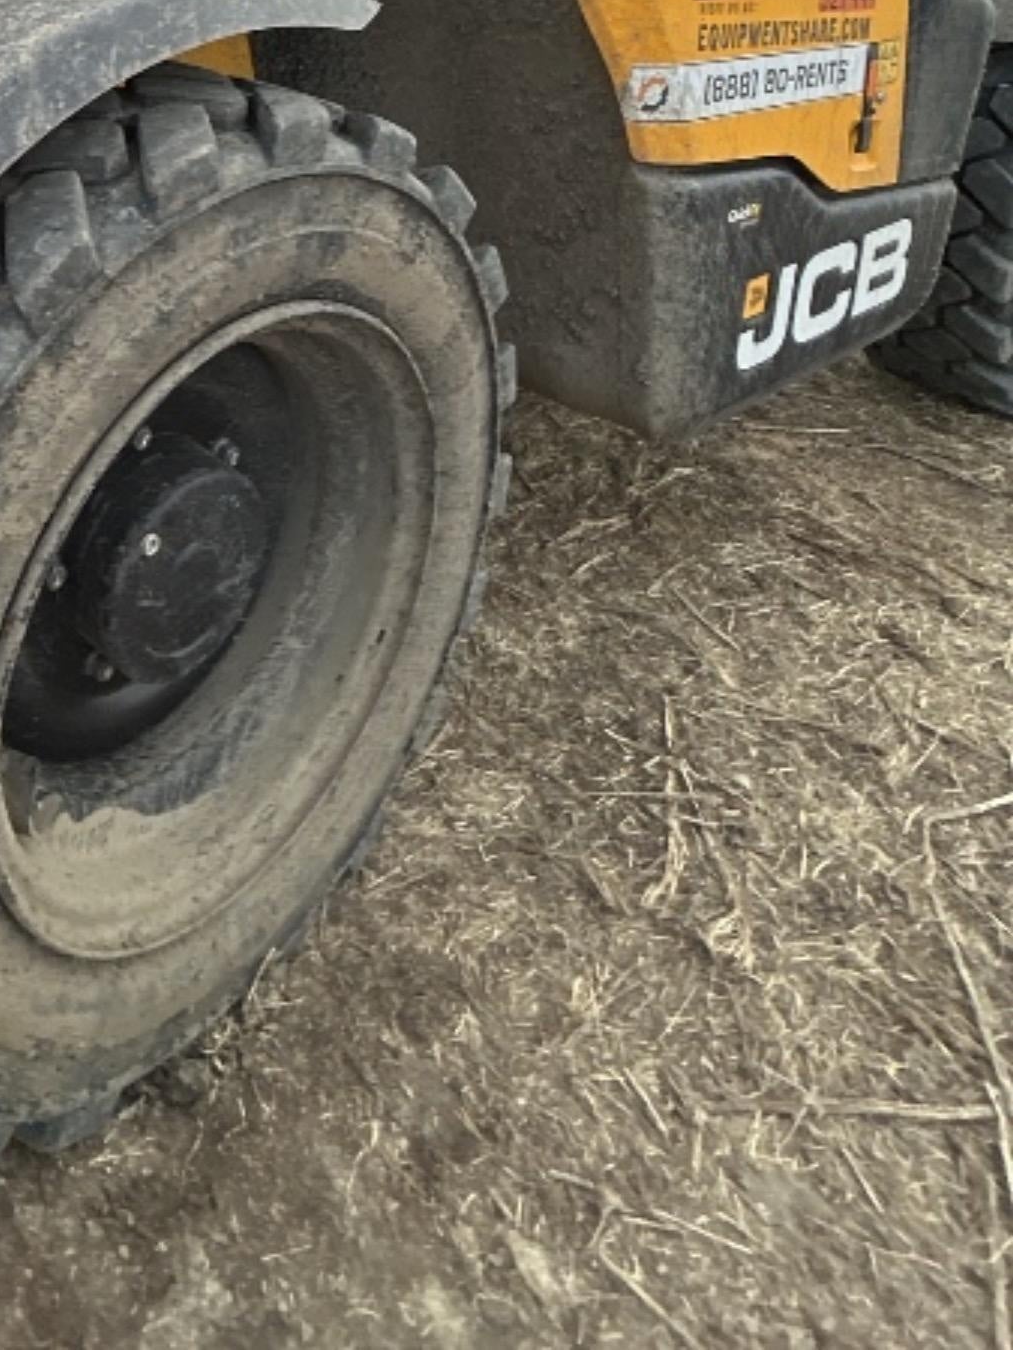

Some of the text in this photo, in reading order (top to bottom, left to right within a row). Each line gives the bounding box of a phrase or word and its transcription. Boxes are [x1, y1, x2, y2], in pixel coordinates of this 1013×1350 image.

[697, 17, 871, 51] EQUIPMENTSHARE.COM
[703, 59, 850, 106] (888) 80-RENTS
[736, 218, 913, 371] JCB
